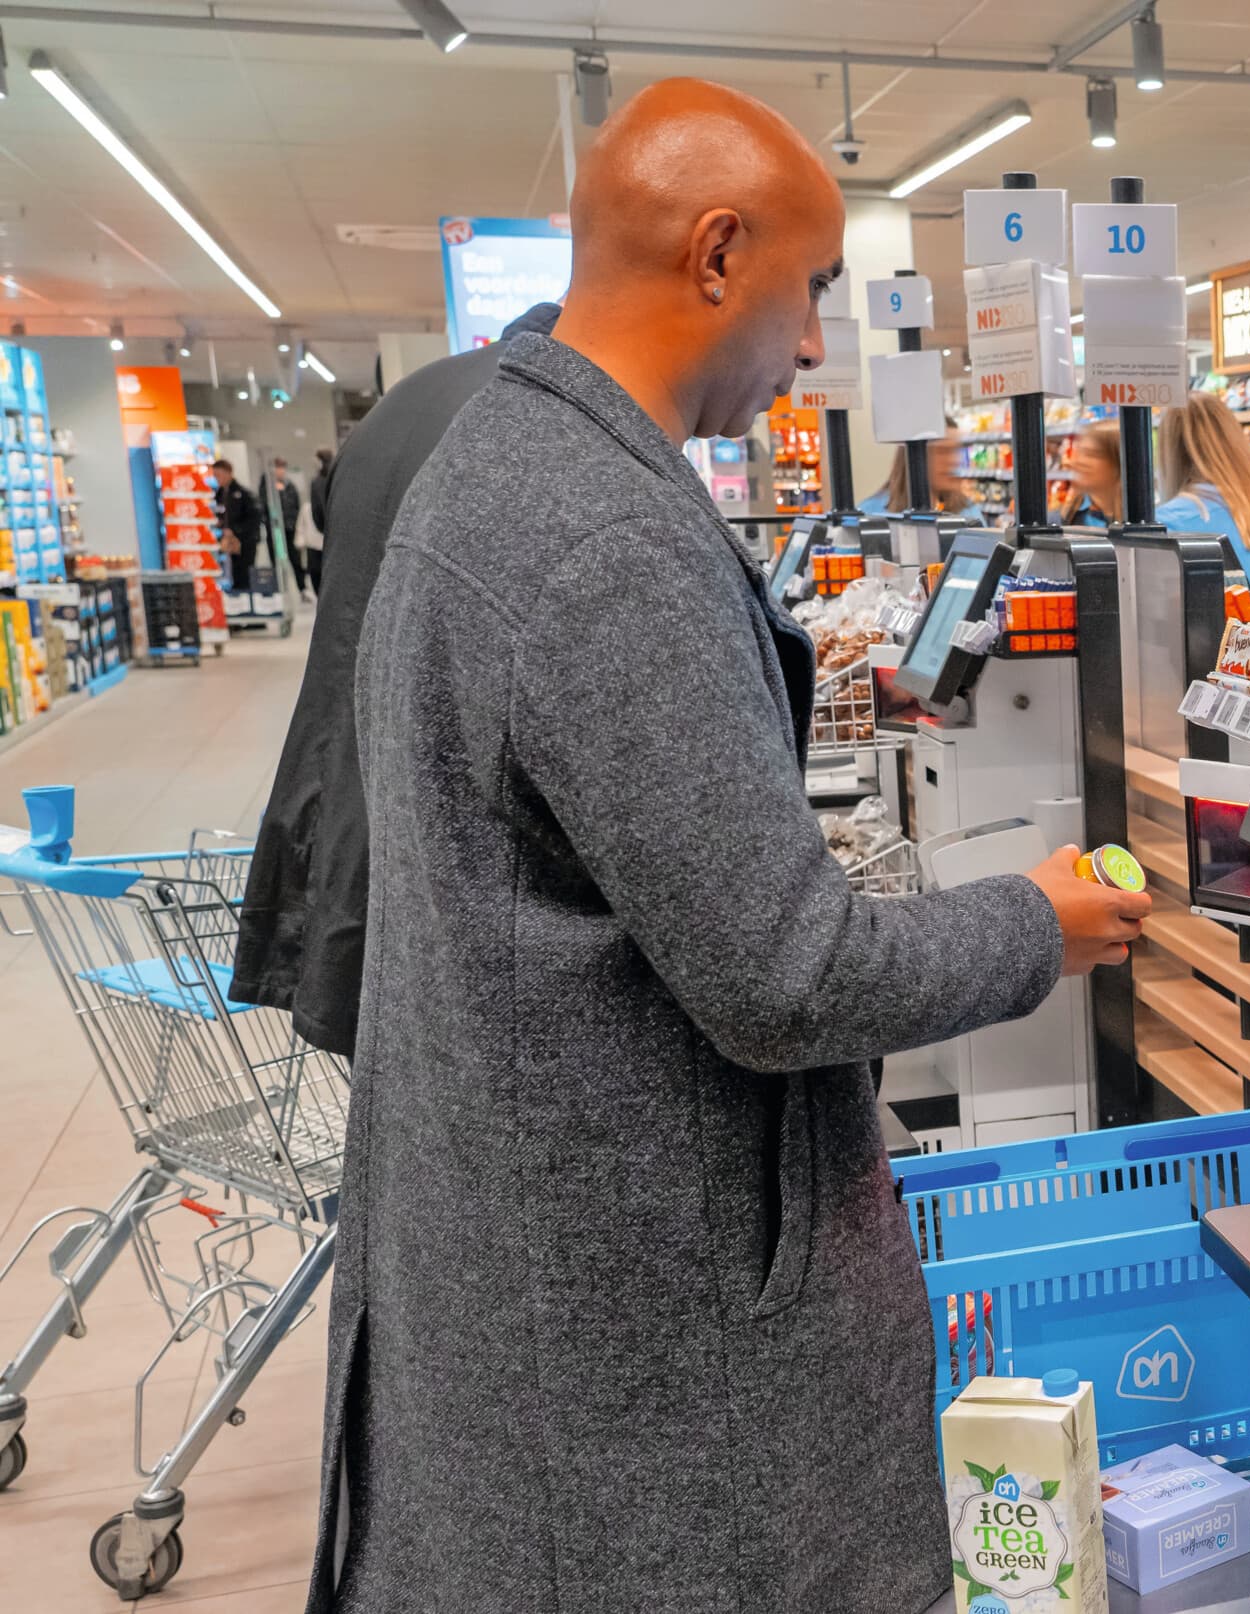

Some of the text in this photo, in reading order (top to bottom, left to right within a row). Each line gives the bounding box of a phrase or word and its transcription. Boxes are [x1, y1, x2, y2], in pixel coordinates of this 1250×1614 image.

[1004, 212, 1023, 242] 6
[1107, 225, 1146, 254] 10
[890, 292, 902, 313] 9
[1101, 383, 1173, 404] NIX18
[980, 1501, 1038, 1528] ice
[973, 1526, 1048, 1555] Tea
[1165, 1513, 1231, 1549] CREAMER
